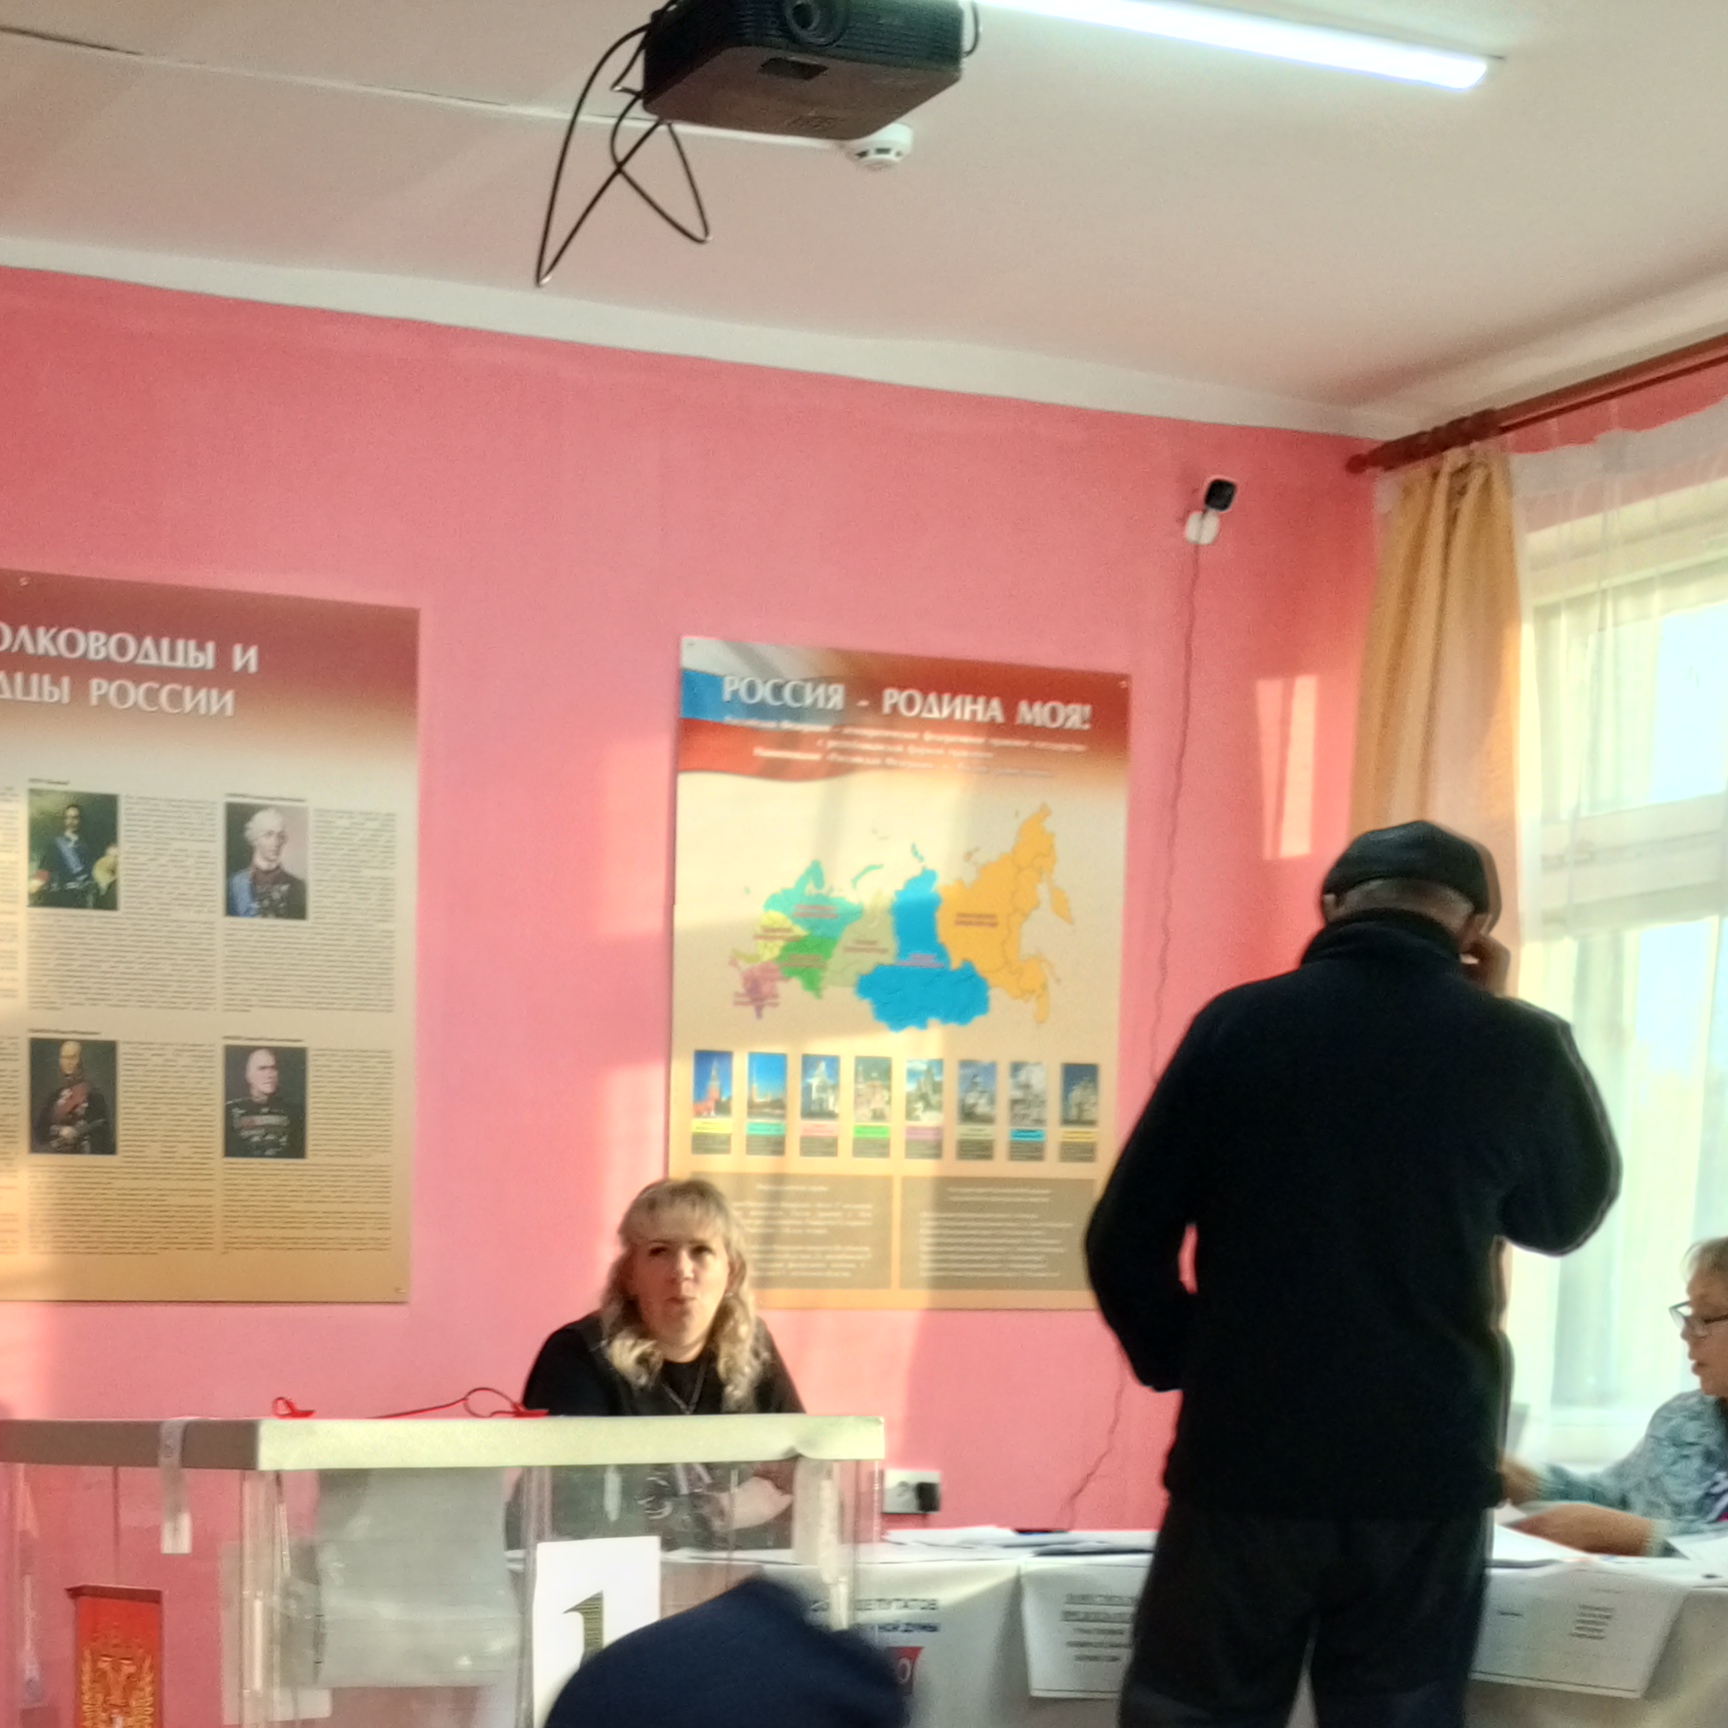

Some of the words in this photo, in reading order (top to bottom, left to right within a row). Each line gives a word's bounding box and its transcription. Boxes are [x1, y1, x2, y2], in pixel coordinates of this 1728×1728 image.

[232, 644, 259, 674] И
[88, 678, 235, 717] РОССИИ
[722, 675, 845, 711] РОССИЯ
[882, 687, 1004, 723] РОДИНА
[1016, 700, 1092, 730] МОЯ!
[563, 1589, 604, 1670] 1
